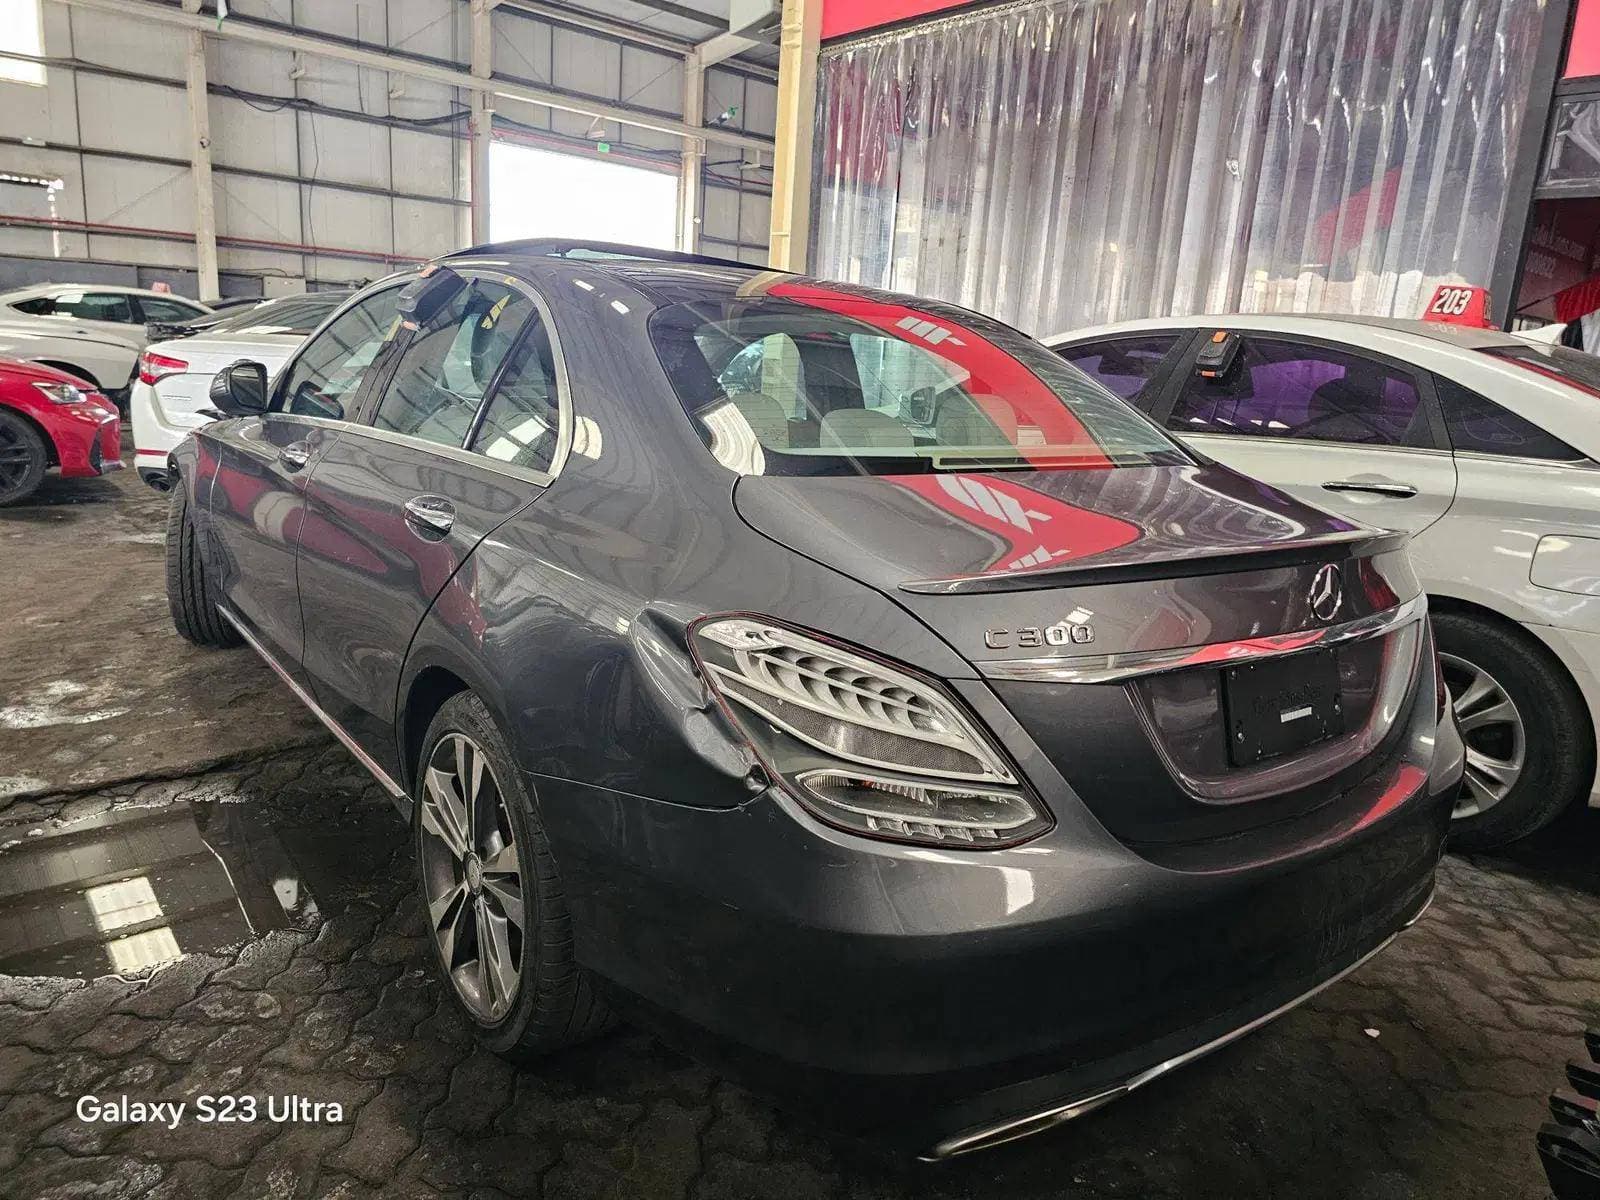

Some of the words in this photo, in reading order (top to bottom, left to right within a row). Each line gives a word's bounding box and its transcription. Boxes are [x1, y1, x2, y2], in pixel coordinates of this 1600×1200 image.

[1430, 288, 1473, 316] 203
[984, 628, 1010, 649] C
[1017, 624, 1096, 648] 300
